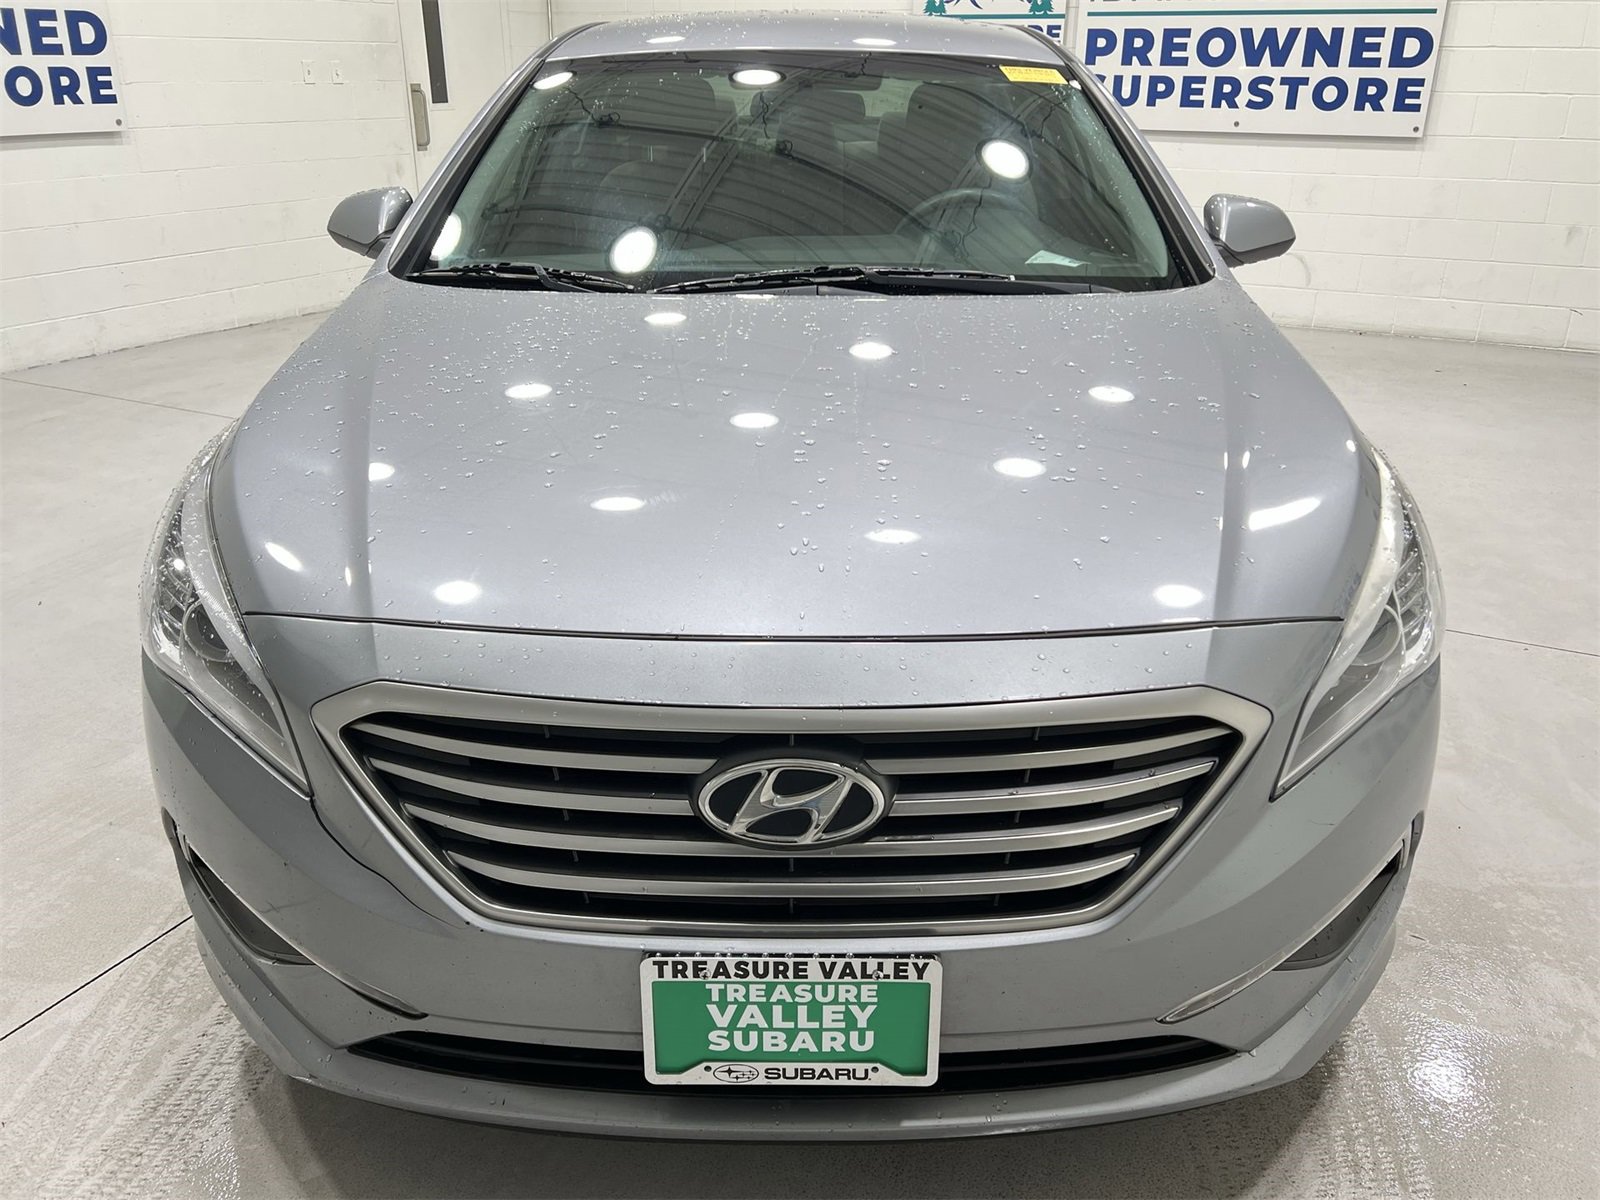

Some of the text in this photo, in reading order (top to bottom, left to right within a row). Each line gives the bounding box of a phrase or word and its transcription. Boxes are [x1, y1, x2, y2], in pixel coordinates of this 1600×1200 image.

[1085, 27, 1434, 68] PREOWNED
[4, 65, 118, 107] ORE
[1095, 74, 1425, 112] UPERSTORE
[652, 961, 930, 980] TREASURE VALLEY
[705, 983, 878, 1003] TREASURE
[705, 1004, 878, 1029] VALLEY
[707, 1030, 875, 1052] SUBARU
[764, 1067, 871, 1081] SUBARU
